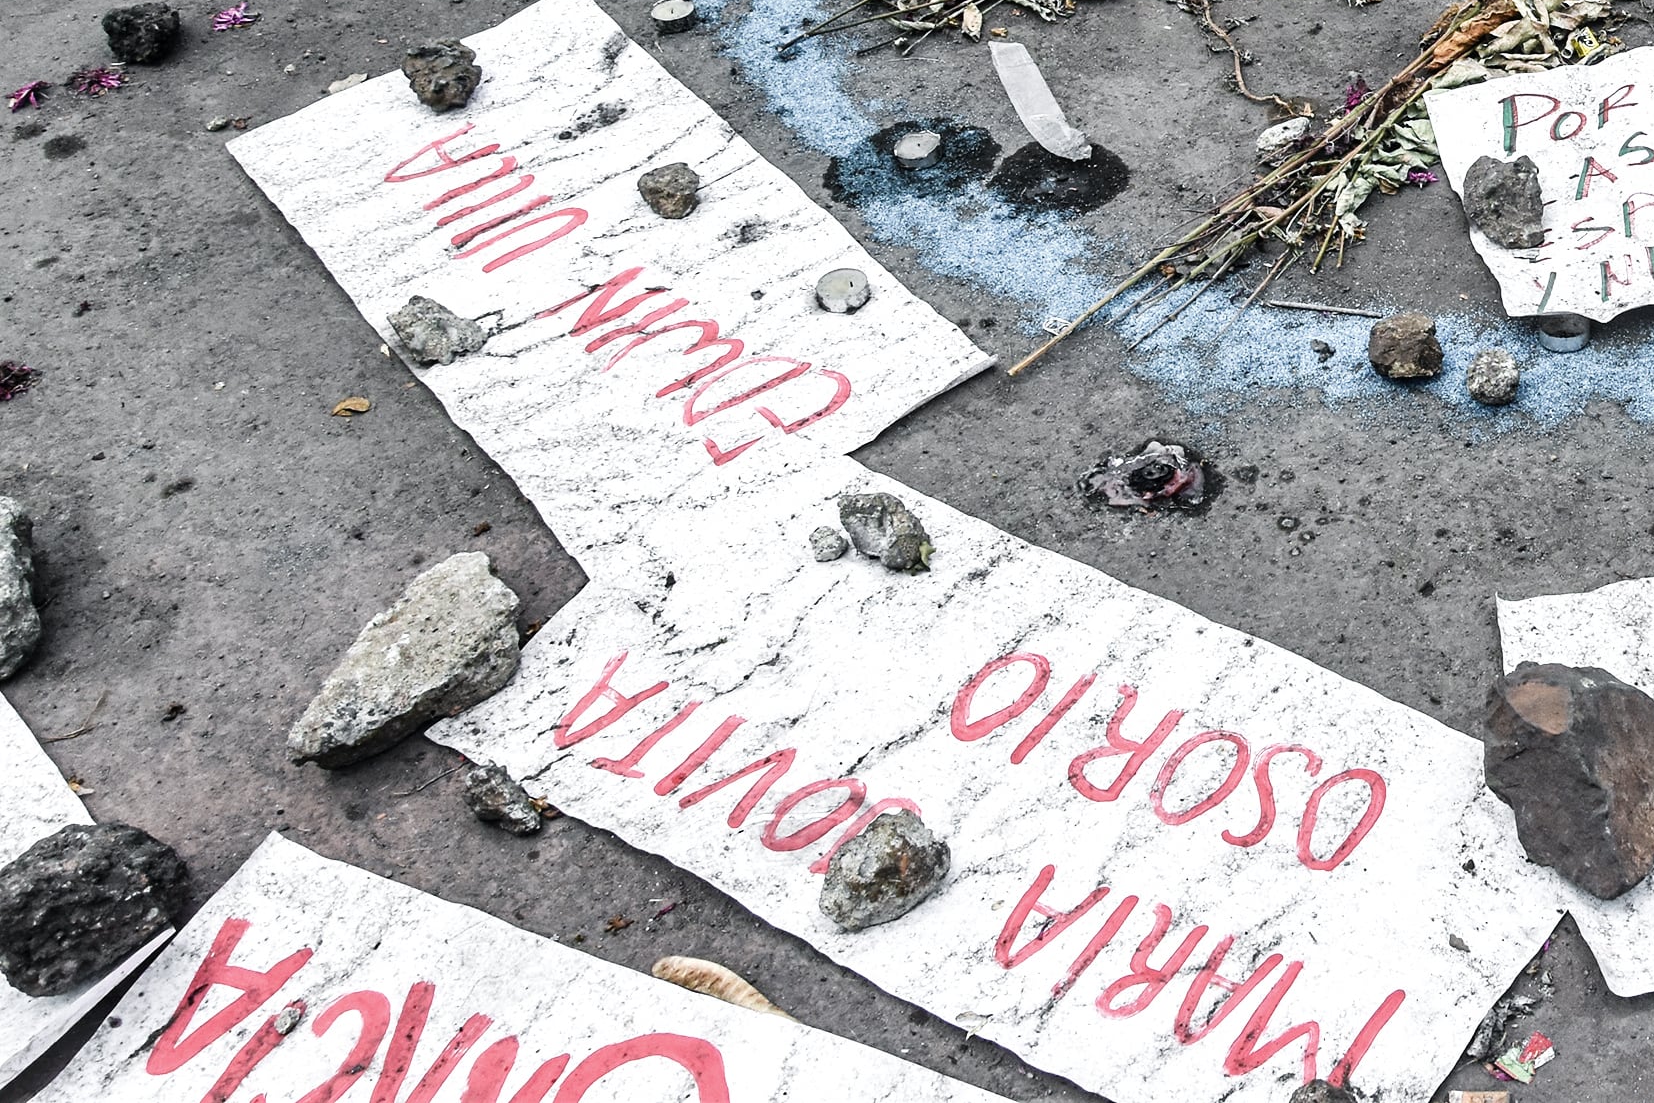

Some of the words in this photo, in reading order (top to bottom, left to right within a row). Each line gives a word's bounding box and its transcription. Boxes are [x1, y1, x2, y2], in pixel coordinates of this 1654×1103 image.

[1498, 84, 1638, 156] POR
[950, 650, 1388, 870] OSORIO
[997, 863, 1405, 1088] MARIA
